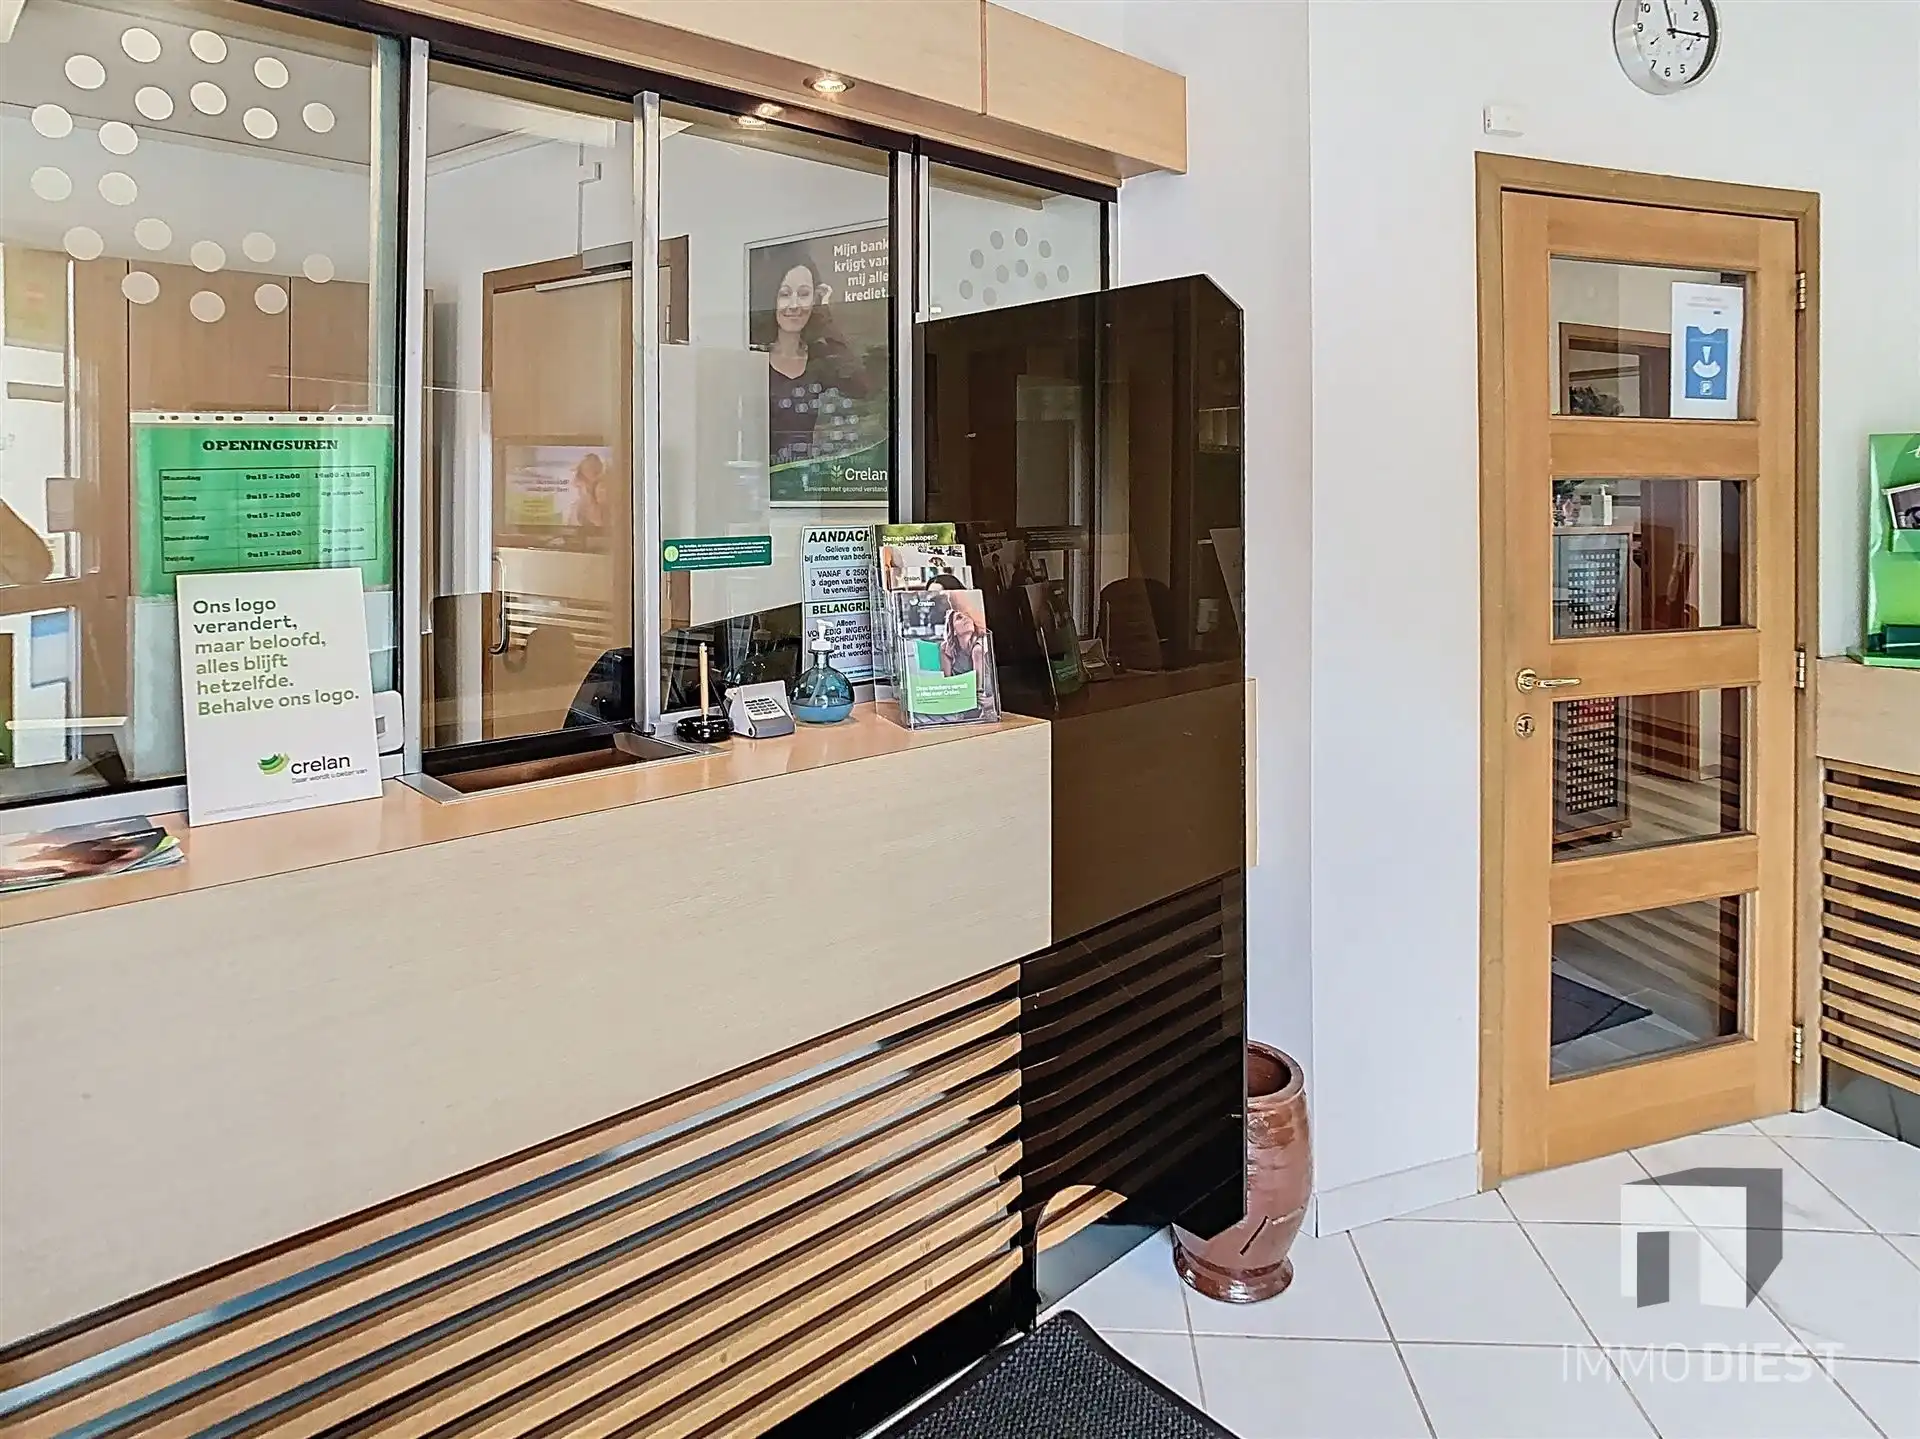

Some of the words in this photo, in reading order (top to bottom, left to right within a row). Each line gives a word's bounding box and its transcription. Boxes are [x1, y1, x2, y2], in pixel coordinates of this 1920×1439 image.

[1640, 3, 1651, 13] 10
[1692, 11, 1699, 21] 2
[1636, 22, 1644, 33] 9
[1651, 60, 1657, 70] 7
[1679, 64, 1686, 74] 5
[1664, 67, 1671, 77] 6
[833, 243, 857, 257] Mijn
[860, 238, 888, 253] bank
[834, 257, 865, 272] krijgt
[868, 256, 888, 268] van
[847, 272, 865, 287] mij
[868, 270, 888, 284] alle
[844, 286, 888, 303] krediet.
[202, 439, 338, 451] OPENINGSUREN
[844, 467, 888, 481] Crelan
[842, 485, 863, 493] gezond
[825, 545, 850, 553] Gelieve
[804, 554, 813, 563] bij
[814, 554, 839, 562] afname
[817, 569, 841, 578] VANAF
[811, 579, 816, 587] 3
[818, 579, 840, 587] dagen
[193, 600, 231, 614] Ons
[235, 598, 276, 614] logo
[193, 615, 298, 634] verandert,
[195, 641, 245, 654] maar
[249, 631, 326, 650] beloofd,
[842, 642, 853, 650] het
[196, 659, 239, 675] alles
[244, 653, 288, 673] blijft
[197, 674, 294, 695] hetzelfde.
[198, 697, 274, 716] Behalve
[278, 693, 311, 708] ons
[315, 689, 360, 705] logo.
[291, 755, 350, 775] crelan
